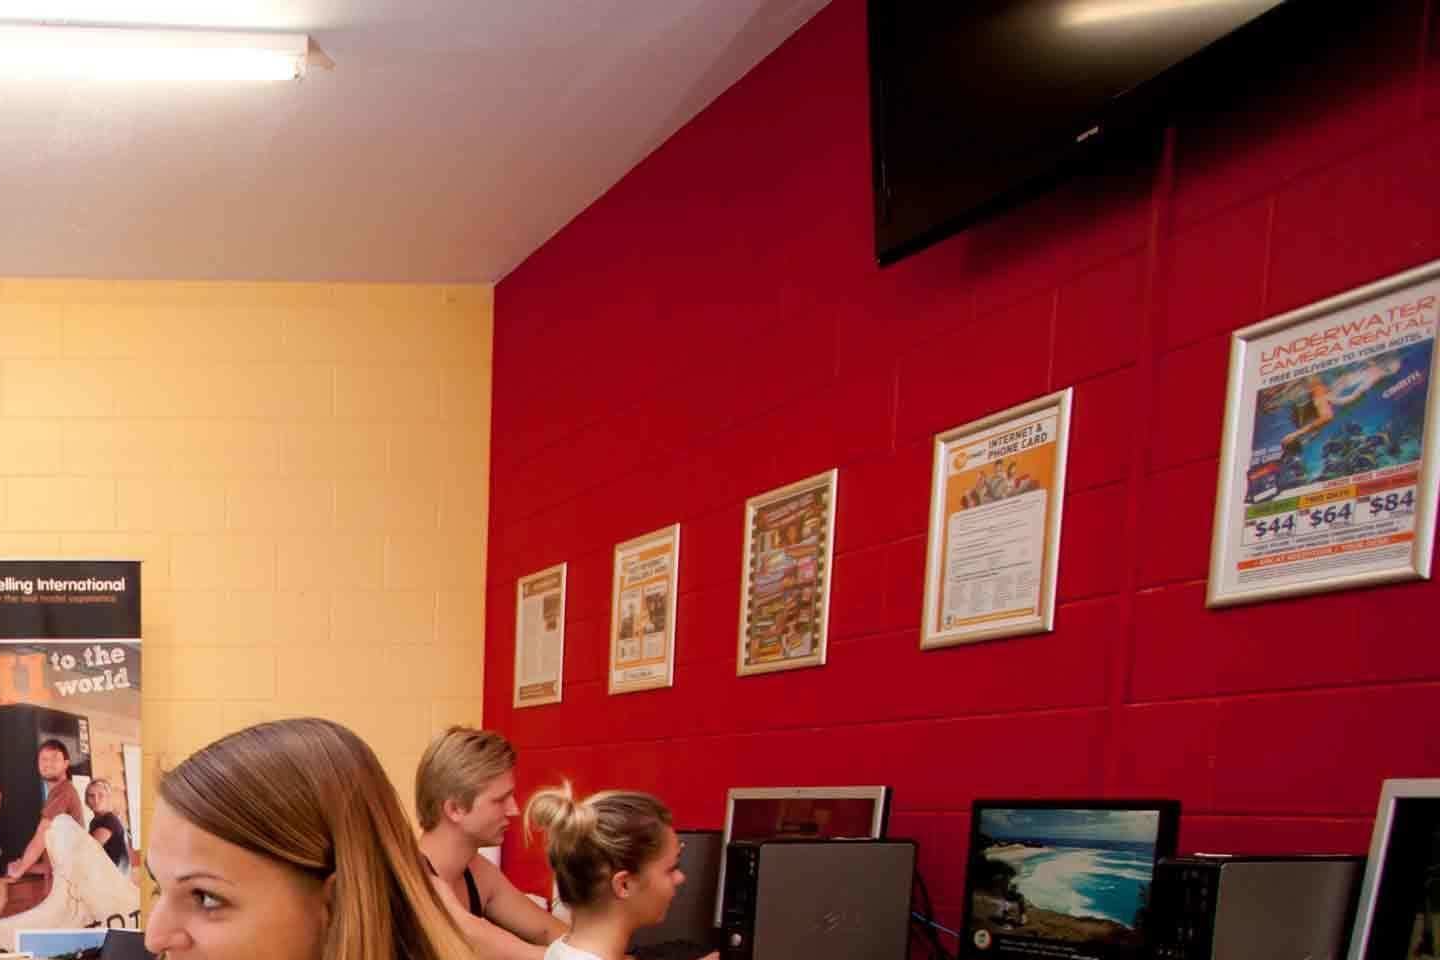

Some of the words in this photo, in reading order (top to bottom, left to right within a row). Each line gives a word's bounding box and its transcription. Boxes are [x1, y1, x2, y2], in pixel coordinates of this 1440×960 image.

[1260, 294, 1437, 362] UNDERWATER
[1259, 341, 1344, 376] CAMERA
[1348, 314, 1434, 348] RENTAL
[1294, 357, 1339, 377] DELIVERY
[987, 442, 1018, 459] PHONE
[1020, 432, 1048, 448] CARD
[988, 426, 1033, 448] INTERNET
[1035, 423, 1043, 432] &
[1368, 488, 1414, 515] $84
[1254, 513, 1295, 537] $44
[1310, 502, 1352, 528] $64
[37, 577, 126, 592] International
[50, 651, 76, 671] to
[84, 645, 125, 666] the
[54, 667, 131, 697] world
